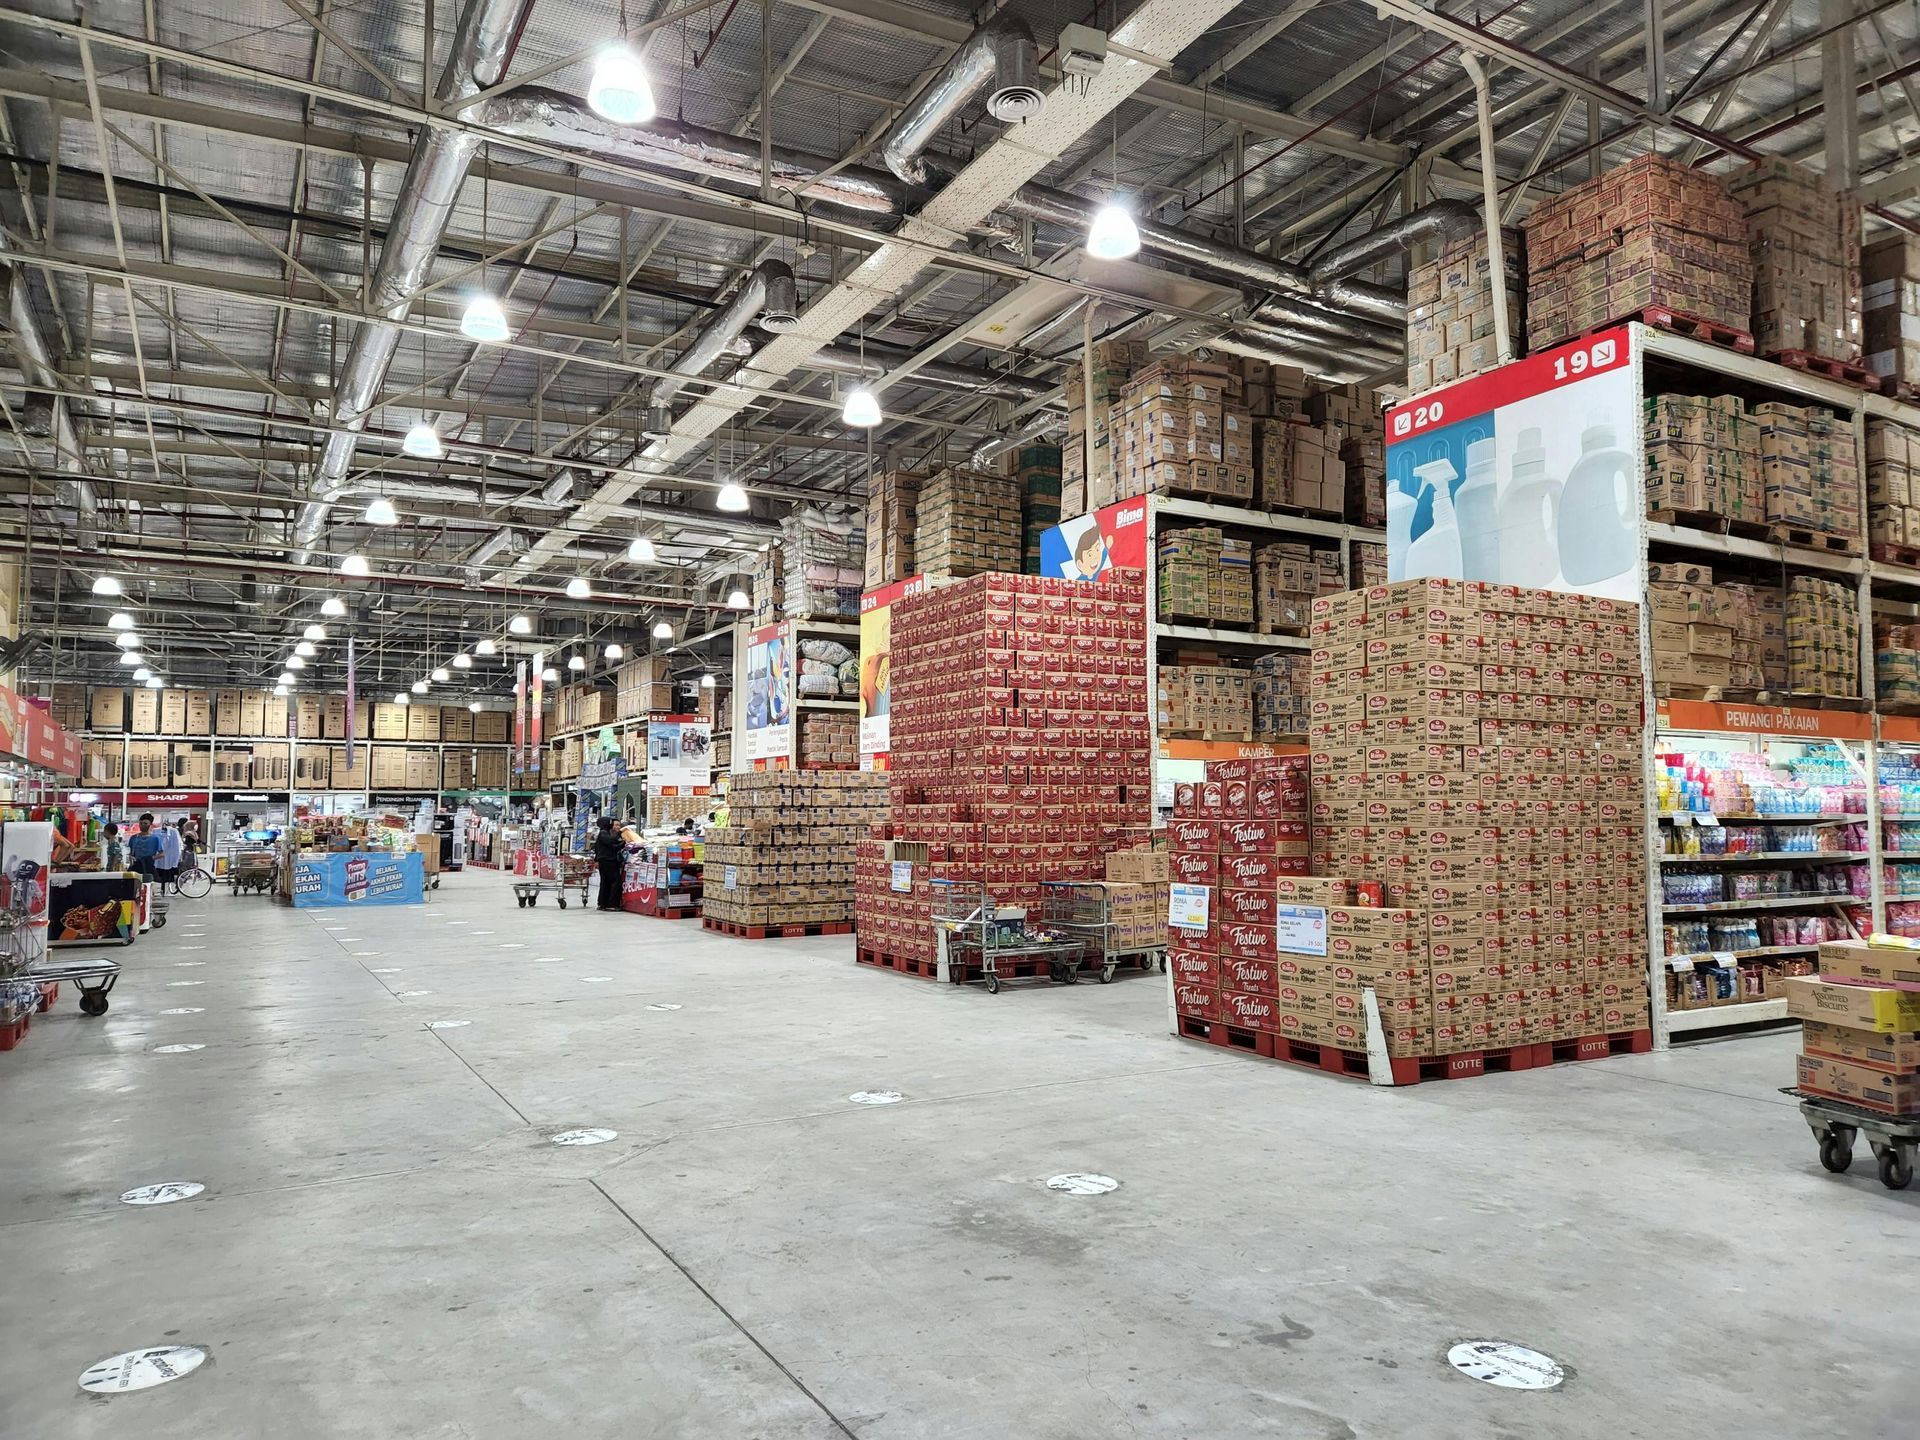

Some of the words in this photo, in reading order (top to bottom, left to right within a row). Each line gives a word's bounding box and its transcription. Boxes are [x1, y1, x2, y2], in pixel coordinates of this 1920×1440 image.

[1554, 350, 1588, 380] 19
[1414, 402, 1443, 428] 20
[1645, 431, 1659, 439] HIT
[1669, 427, 1681, 437] HIT
[1704, 433, 1714, 441] HIT
[1646, 478, 1662, 486] HIT
[1671, 474, 1683, 483] HIT
[1705, 478, 1715, 486] HIT
[1116, 507, 1143, 526] Bima
[904, 583, 914, 594] 23
[867, 597, 877, 607] 24
[1727, 710, 1773, 729] PEWANGI
[1776, 715, 1819, 731] PAKAIAN
[1238, 747, 1275, 758] KAMPER
[1215, 762, 1246, 780] Festive
[1282, 789, 1304, 800] Festive
[1176, 822, 1209, 841] Festive
[1230, 823, 1265, 843] Festive
[1185, 842, 1200, 850] Treats
[1240, 844, 1256, 852] Treats
[348, 863, 366, 872] Promo
[1177, 855, 1208, 873] Festive
[1232, 857, 1267, 877] Festive
[375, 864, 398, 876] BELANJA
[348, 871, 366, 884] HITS
[1186, 874, 1200, 882] Treats
[1242, 878, 1258, 887] Treats
[1232, 892, 1267, 912] Festive
[1243, 913, 1259, 921] Treats
[784, 926, 804, 935] LOTTE
[1230, 926, 1268, 946] Festive
[1186, 939, 1201, 949] Treats
[1241, 948, 1257, 956] Treats
[1176, 953, 1208, 972] Festive
[1232, 961, 1268, 981] Festive
[1861, 965, 1881, 975] Rinso
[1185, 973, 1199, 982] Treats
[1242, 982, 1258, 991] Treats
[1177, 986, 1210, 1005] Festive
[1811, 989, 1849, 1003] ASSORTED
[1187, 1006, 1201, 1015] Treats
[1232, 996, 1270, 1016] Festive
[1817, 999, 1849, 1012] BISCUITS
[1243, 1017, 1260, 1027] Treats
[1582, 1041, 1608, 1052] LOTTE
[1452, 1058, 1482, 1071] LOTTE
